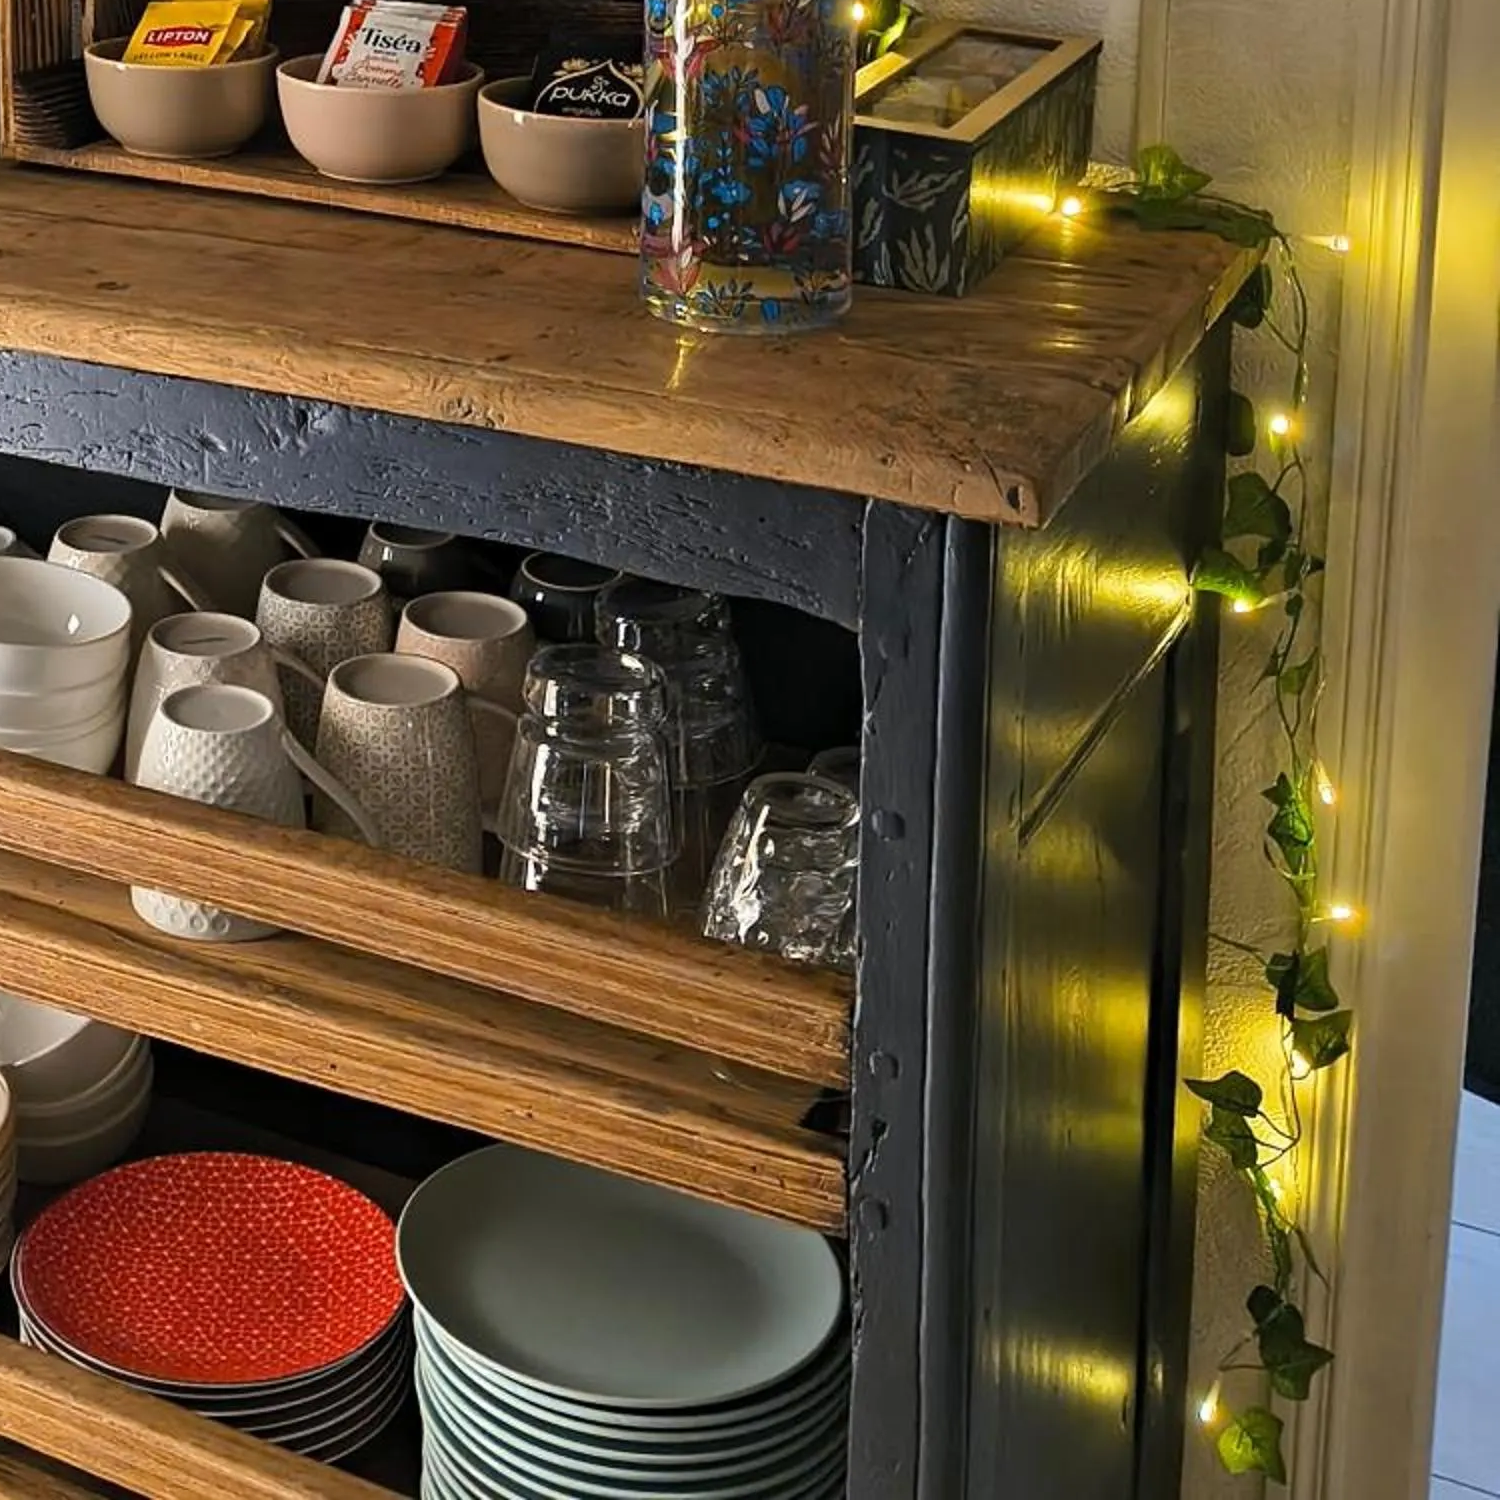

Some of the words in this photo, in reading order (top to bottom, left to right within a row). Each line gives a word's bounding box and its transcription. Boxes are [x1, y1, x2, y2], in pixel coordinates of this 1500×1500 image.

[147, 30, 210, 43] LIPTON
[360, 26, 422, 54] Tiséa
[547, 85, 632, 108] pukka
